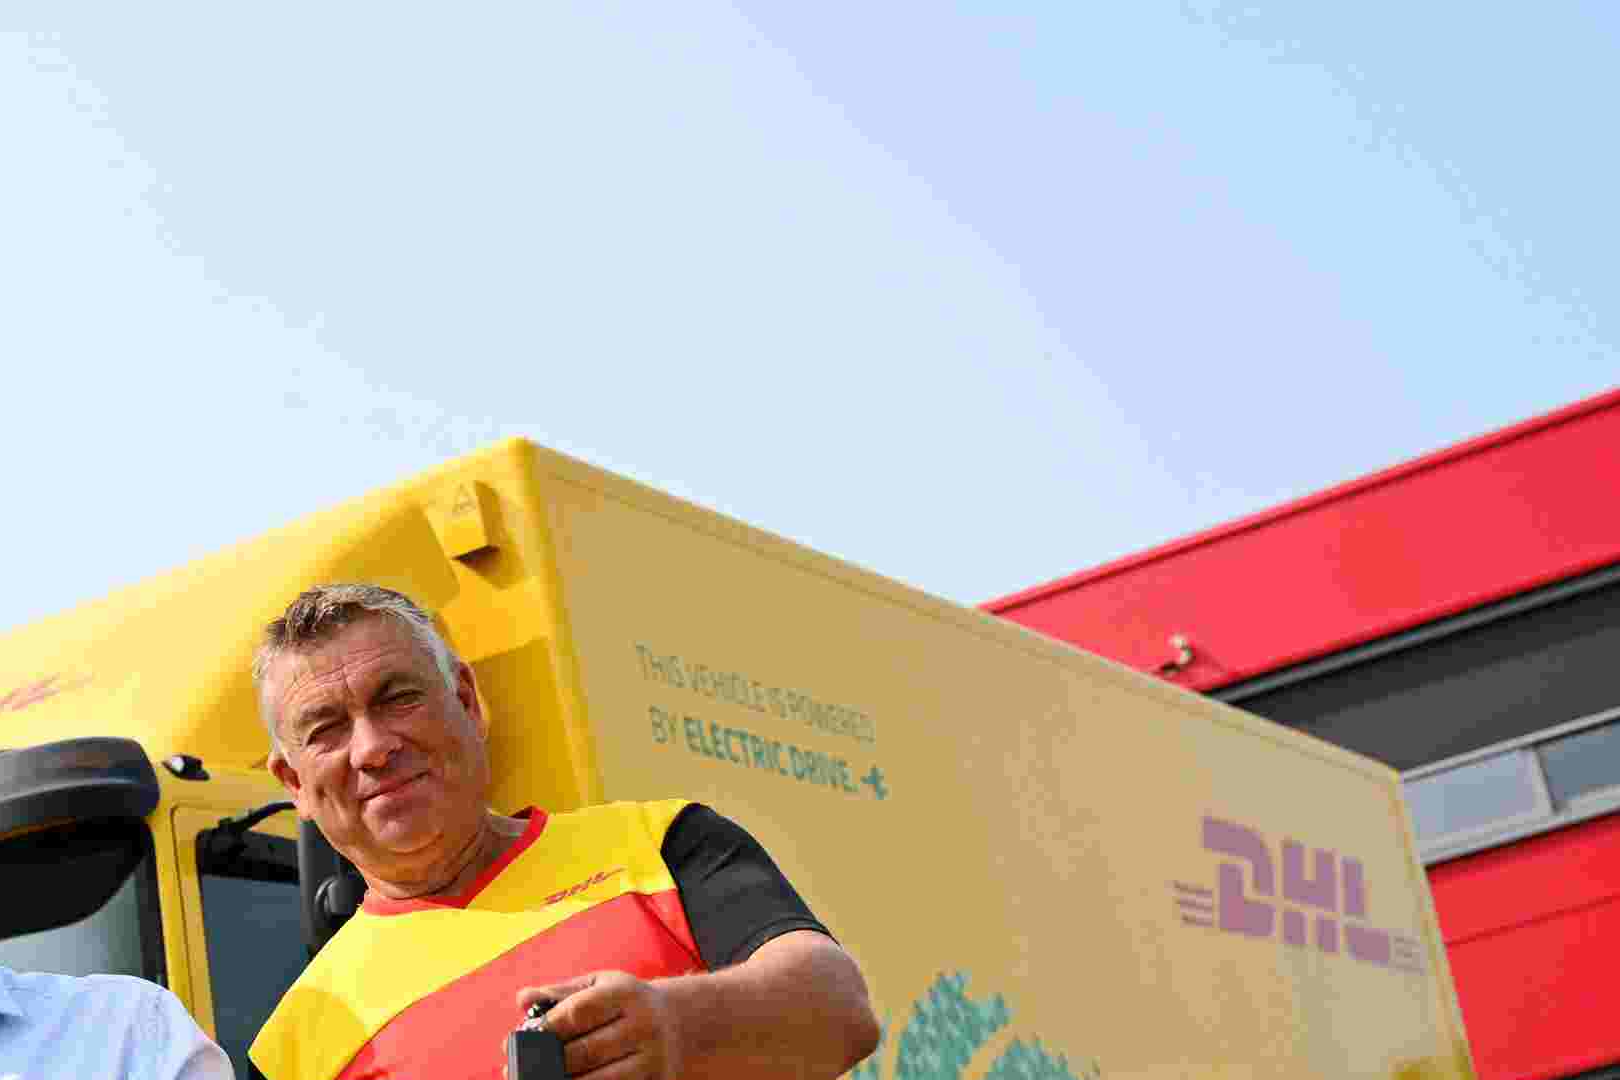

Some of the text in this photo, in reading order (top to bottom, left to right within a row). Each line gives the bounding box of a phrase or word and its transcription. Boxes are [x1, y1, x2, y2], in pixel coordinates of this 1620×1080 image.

[648, 706, 678, 744] BY
[683, 717, 788, 777] ELECTRIC
[1200, 815, 1390, 968] DHL
